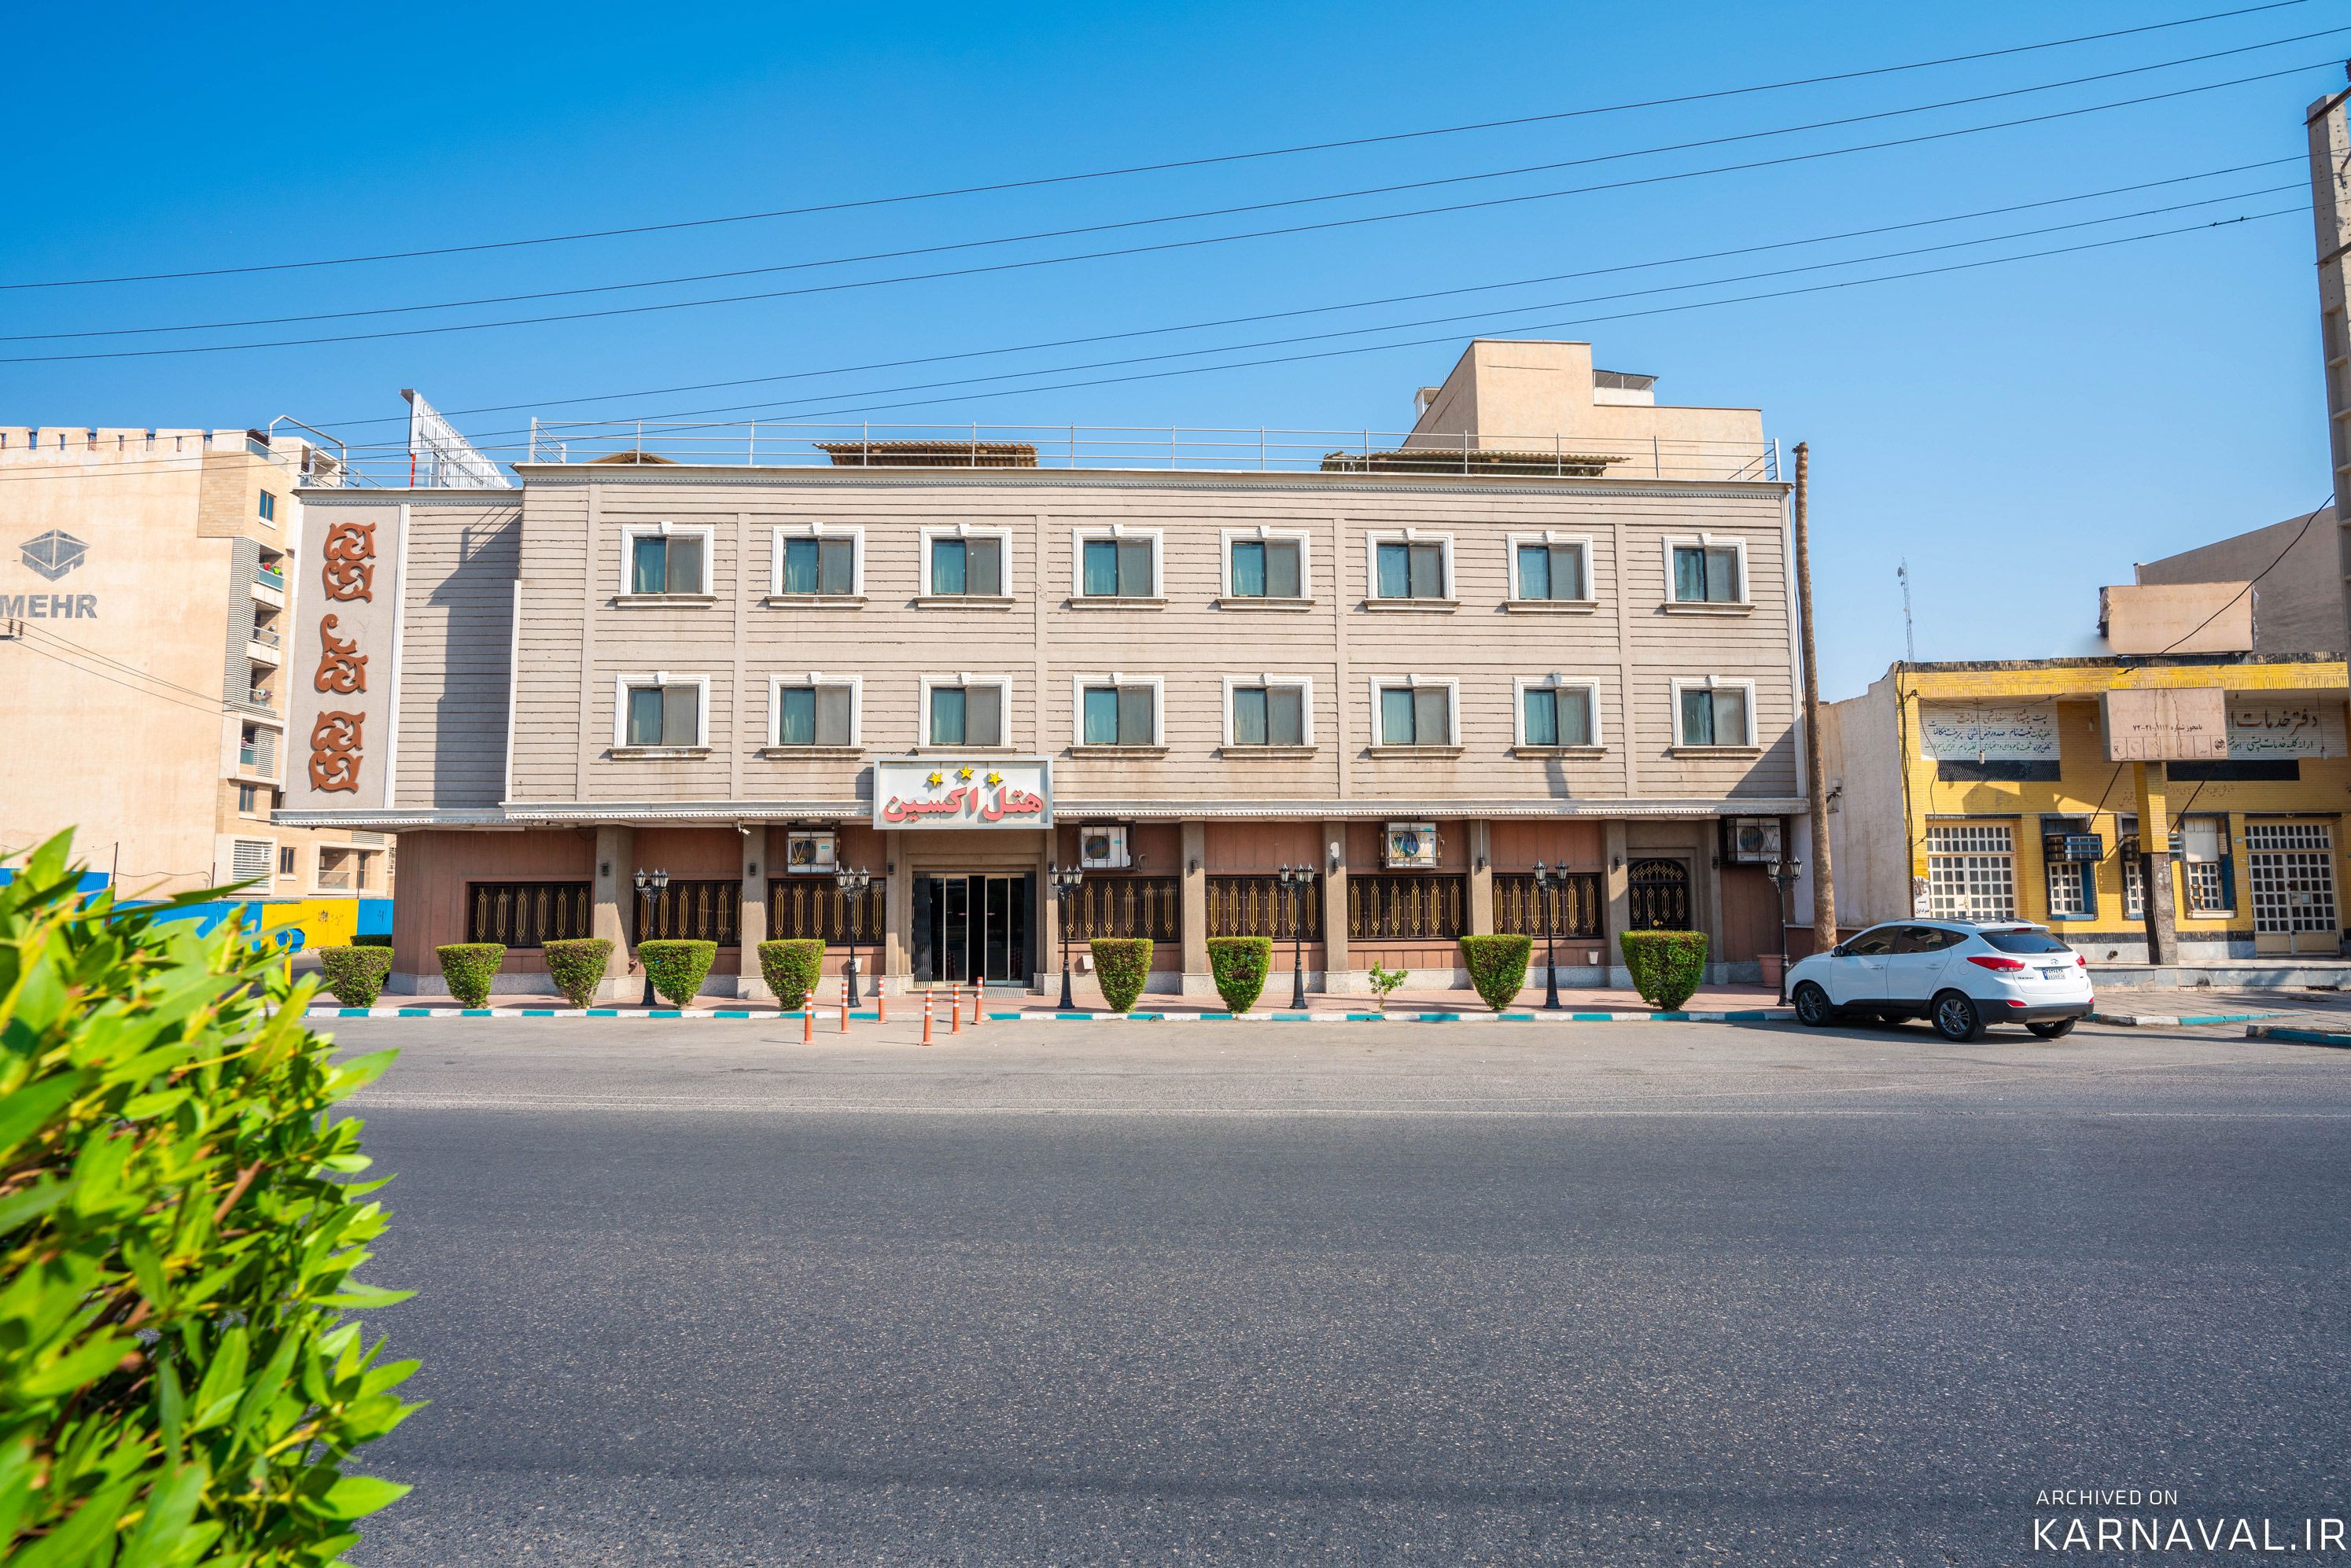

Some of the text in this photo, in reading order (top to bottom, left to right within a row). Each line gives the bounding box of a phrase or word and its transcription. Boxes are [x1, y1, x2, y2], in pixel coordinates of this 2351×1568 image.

[0, 594, 98, 619] MEHR
[2032, 713, 2048, 724] پست
[2236, 709, 2290, 728] خدمات
[2290, 708, 2317, 735] دفتر
[2260, 737, 2287, 749] خدمات
[883, 786, 1044, 822] هتل اکسین
